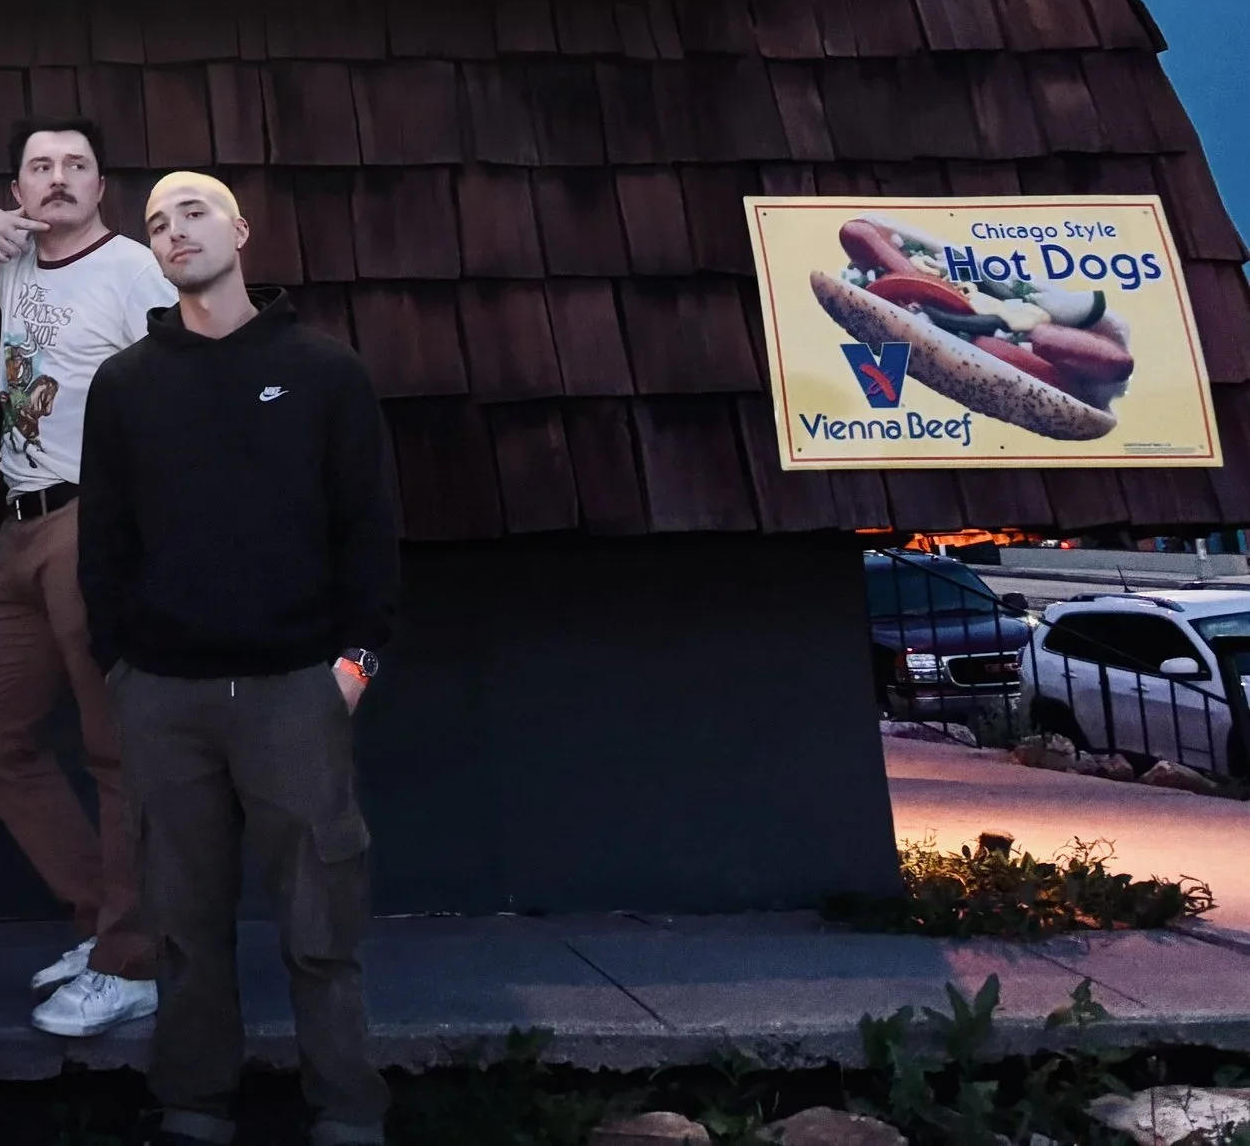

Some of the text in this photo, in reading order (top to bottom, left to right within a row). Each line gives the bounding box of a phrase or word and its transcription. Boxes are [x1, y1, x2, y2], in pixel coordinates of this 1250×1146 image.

[971, 221, 1116, 242] Chicago Style
[944, 244, 1162, 290] Hot Dogs
[263, 386, 282, 395] NIKE
[799, 412, 971, 446] Vienna Beef
